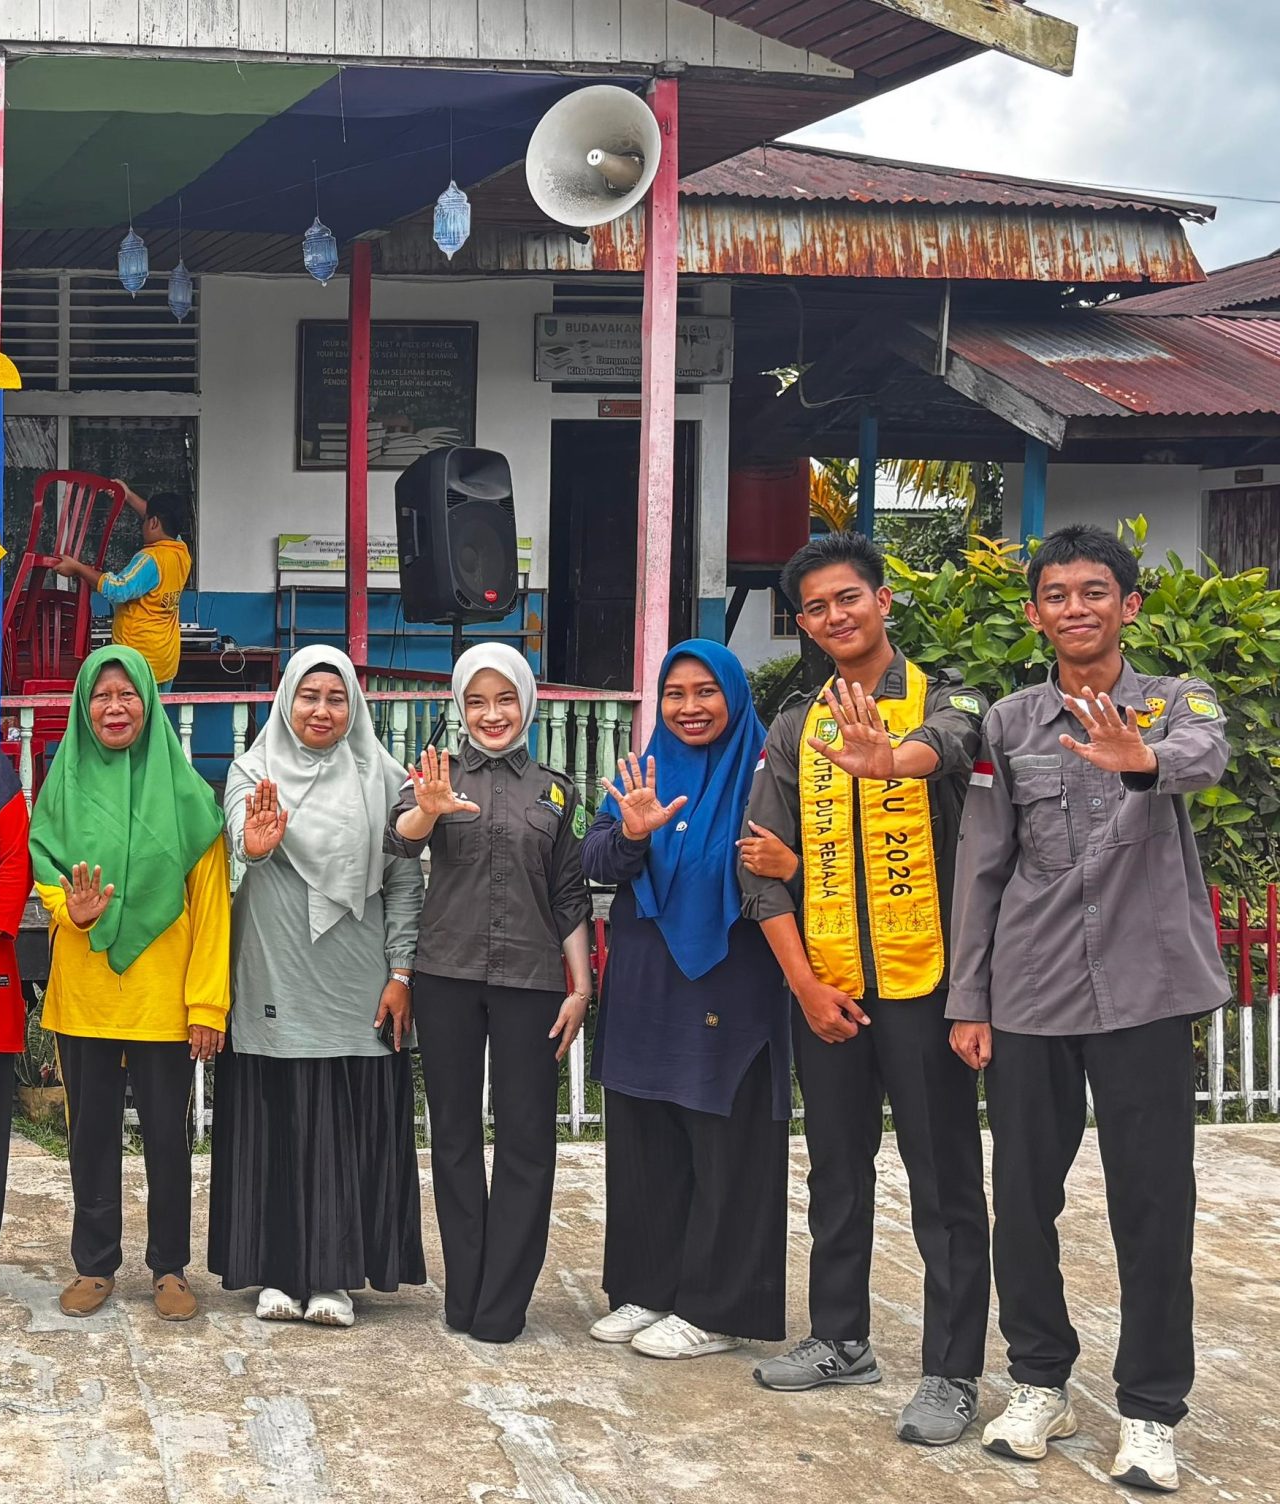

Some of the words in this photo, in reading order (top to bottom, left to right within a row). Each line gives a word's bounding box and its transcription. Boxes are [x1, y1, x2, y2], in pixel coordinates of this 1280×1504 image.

[813, 752, 833, 793] UTRA
[882, 779, 906, 812] AU
[815, 798, 834, 836] DUTA
[818, 840, 839, 899] REMAJA
[884, 831, 912, 897] 2026
